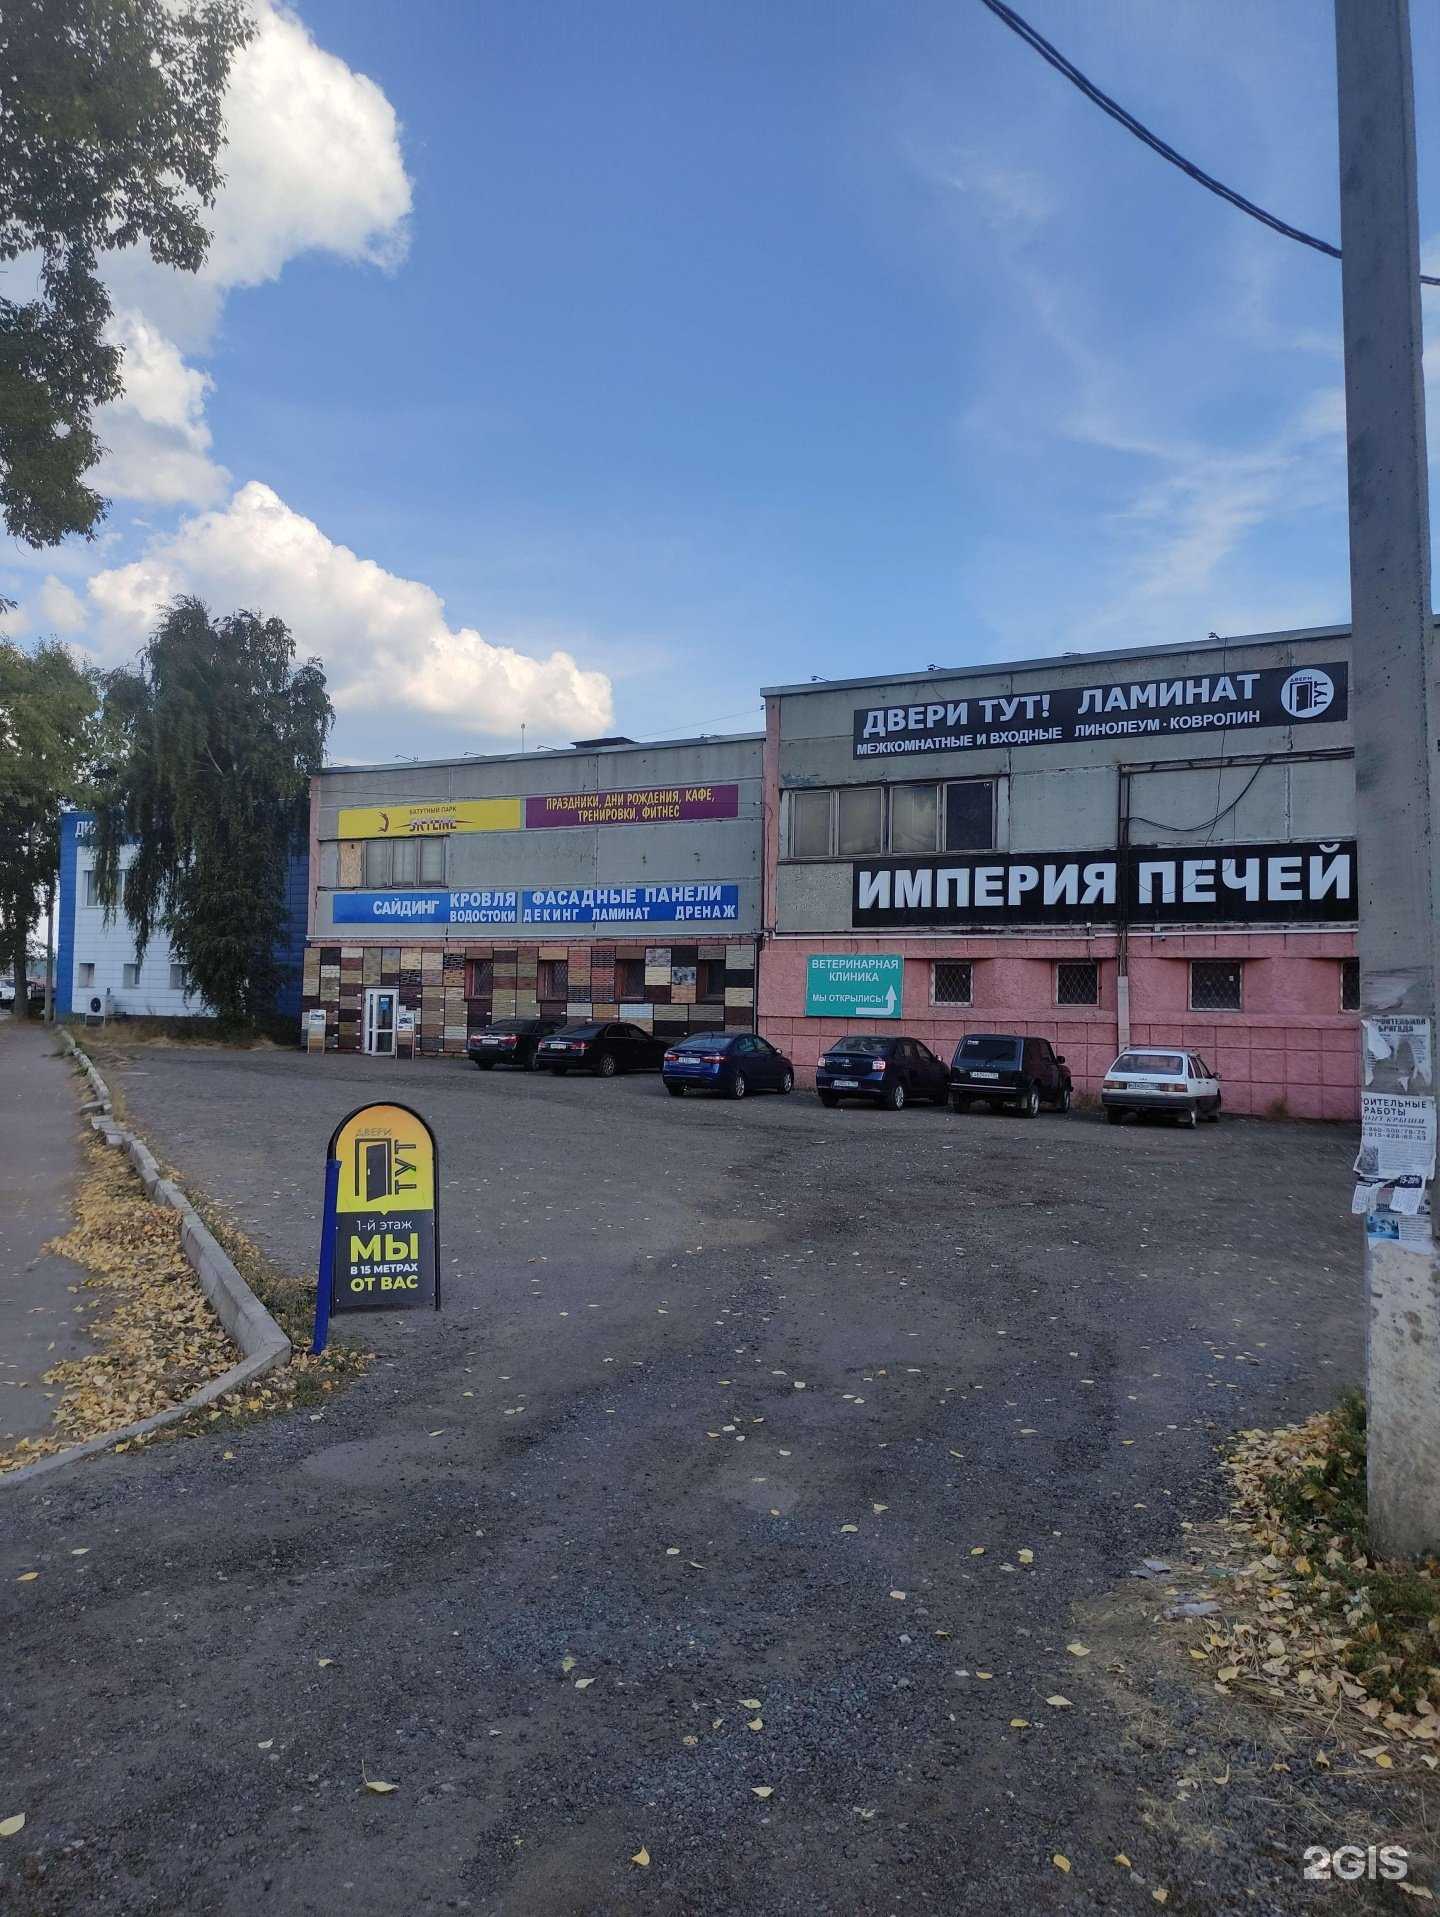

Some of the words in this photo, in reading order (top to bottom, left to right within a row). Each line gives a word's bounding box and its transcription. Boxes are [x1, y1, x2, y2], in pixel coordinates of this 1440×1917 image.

[1077, 673, 1261, 714] ЛАМИНАТ
[863, 702, 968, 739] ДВЕРИ
[978, 694, 1050, 723] ТУТ!
[1074, 718, 1160, 737] ЛИНОЛЕУМ
[1169, 709, 1261, 730] КОВРОЛИН
[856, 735, 973, 755] МЕЖКОМНАТНЫЕ
[976, 734, 987, 746] И
[989, 727, 1064, 745] ВХОДНЫЕ
[546, 796, 602, 811] ПРАЗДНИКИ,
[604, 794, 624, 807] ДНИ
[627, 791, 682, 806] РОЖДЕНИЯ,
[685, 788, 715, 803] КАФЕ,
[578, 808, 639, 823] ТРЕНИРОВКИ,
[641, 805, 680, 820] ФИТНЕС
[1138, 843, 1350, 904] ПЕЧЕЙ
[859, 862, 1117, 909] ИМПЕРИЯ
[450, 892, 516, 907] КРОВЛЯ
[532, 888, 636, 907] ФАСАДНЫЕ
[645, 885, 721, 903] ПАНЕЛИ
[373, 898, 439, 917] САЙДИНГ
[450, 909, 516, 922] ВОДОСТОКИ
[523, 908, 579, 923] ДЕКИНГ
[591, 907, 650, 921] ЛАМИНАТ
[675, 904, 736, 921] ДРЕНАЖ
[812, 959, 899, 969] ВЕТЕРИНАРНАЯ
[829, 971, 880, 982] КЛИНИКА
[812, 993, 827, 1002] МЫ
[1364, 1107, 1406, 1116] РАБОТЫ
[395, 1139, 417, 1195] ТУТ
[356, 1219, 376, 1231] 1-й
[380, 1220, 412, 1230] этаж
[350, 1232, 419, 1263] МЫ
[350, 1266, 358, 1275] В
[360, 1265, 371, 1275] 15
[373, 1263, 418, 1274] МЕТРАХ
[350, 1277, 376, 1292] ОТ
[380, 1274, 419, 1290] ВАС
